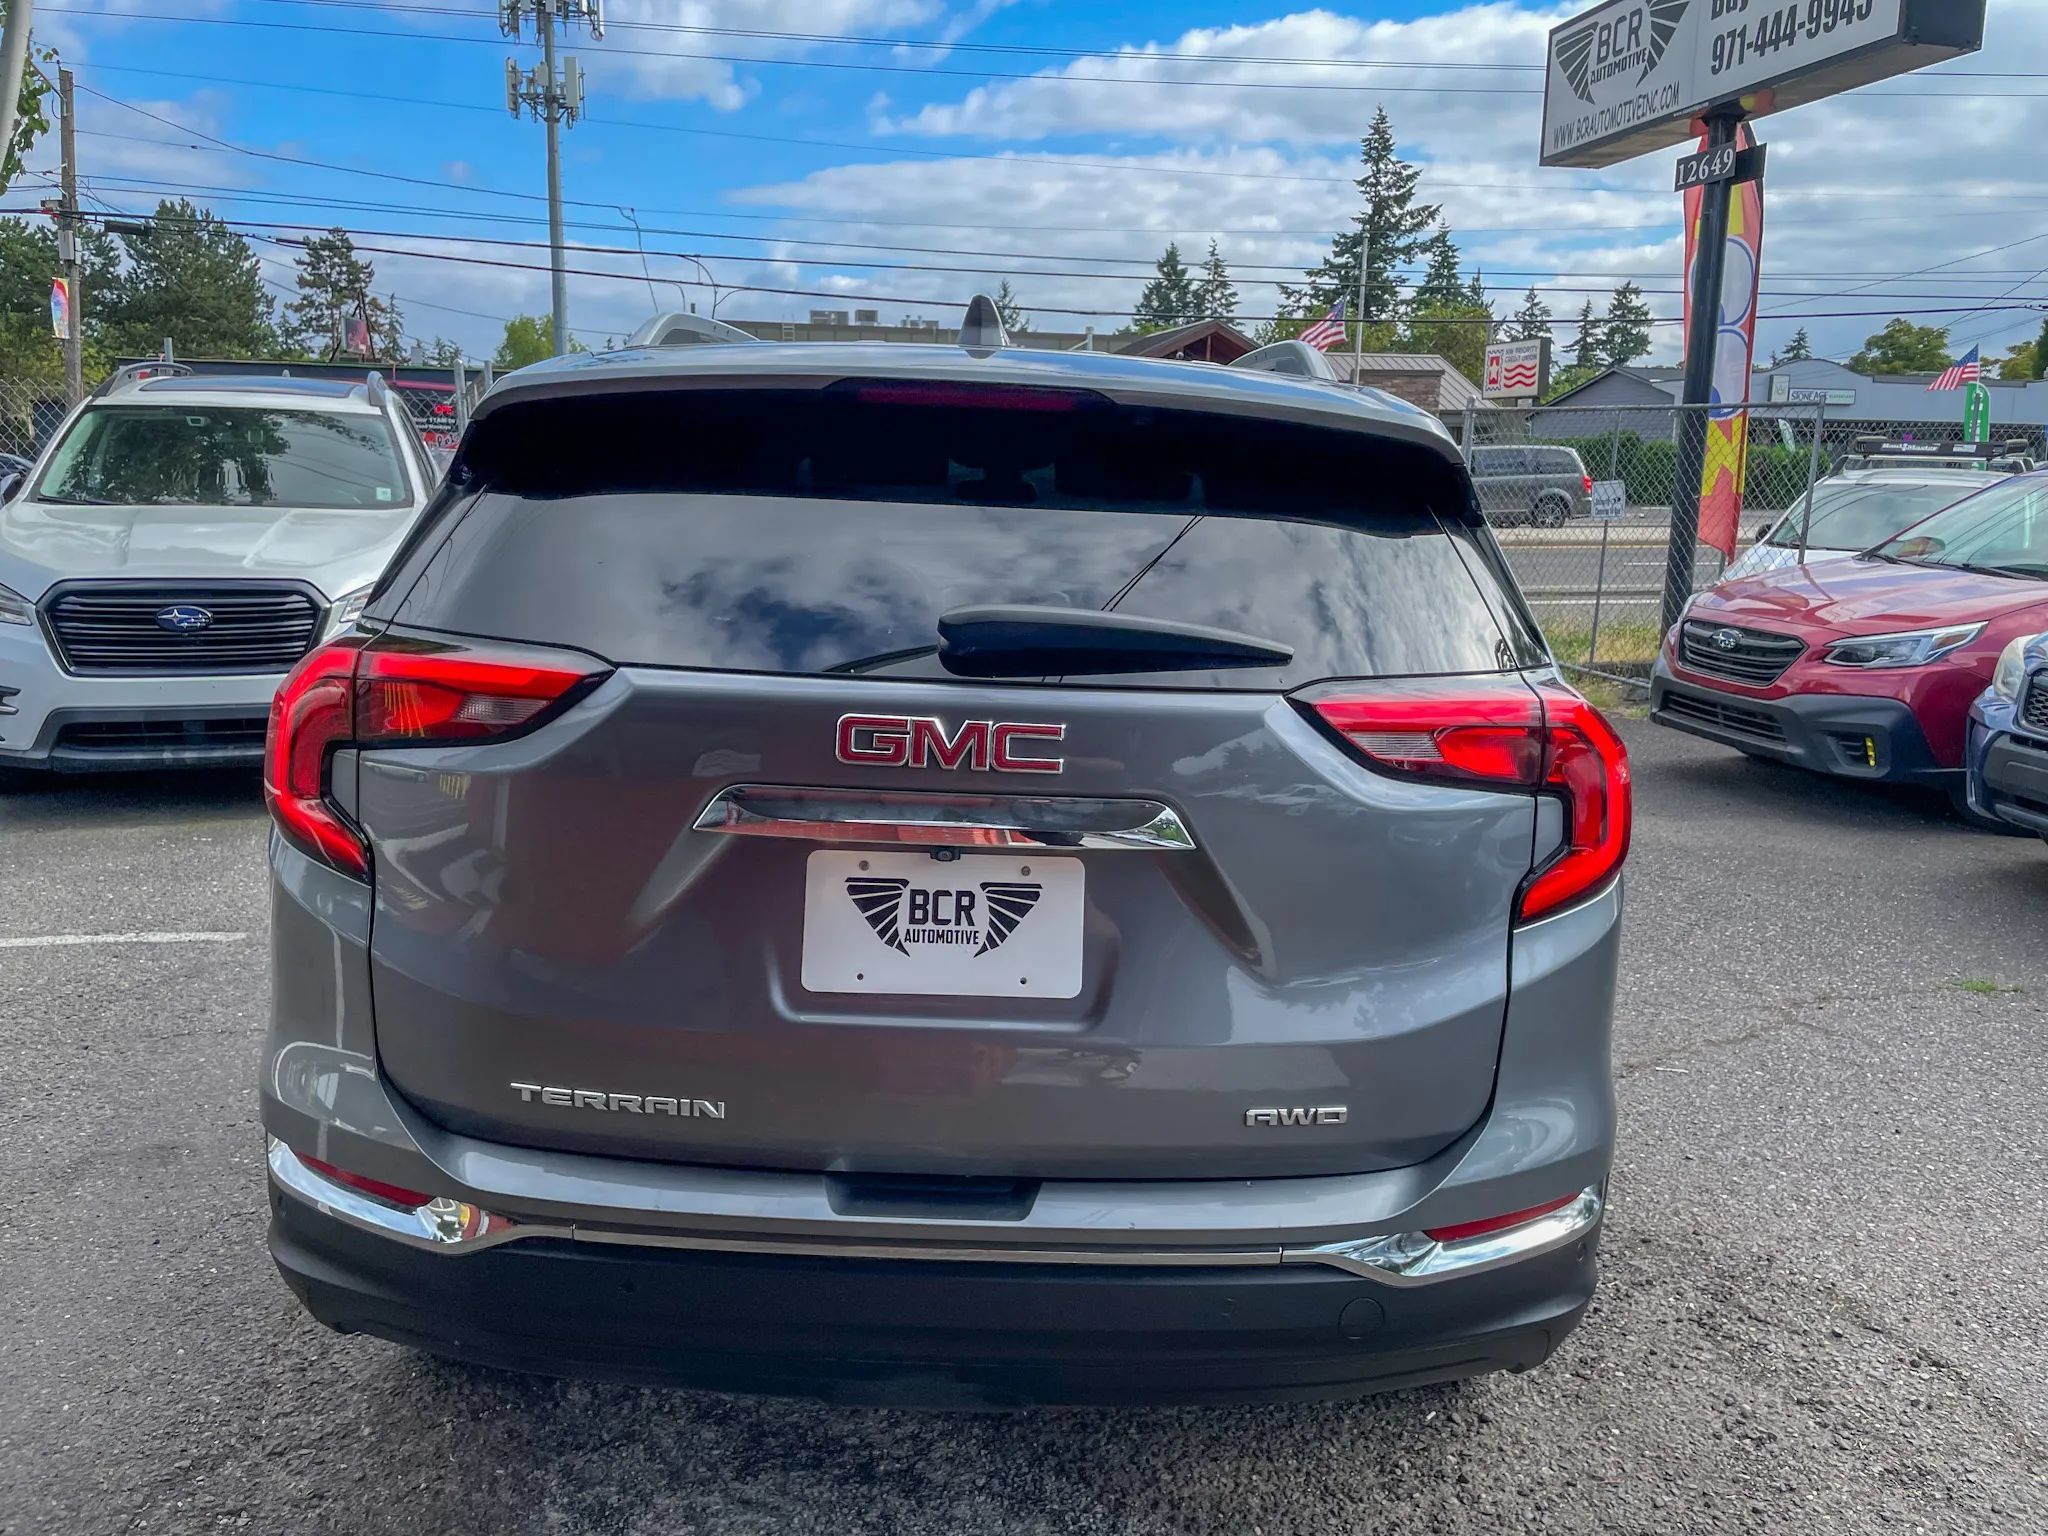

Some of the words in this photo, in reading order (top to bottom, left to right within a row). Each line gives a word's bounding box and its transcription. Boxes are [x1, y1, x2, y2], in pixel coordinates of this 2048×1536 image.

[1596, 8, 1643, 65] BCR
[1590, 48, 1648, 85] AUTOMOTIVE
[1553, 80, 1680, 149] WWW.BCRAUTOMOTIVEINC.COM
[1677, 148, 1734, 186] 12649
[836, 713, 1066, 774] GMC
[908, 888, 976, 926] BCR
[904, 928, 979, 945] AUTOMOTIVE
[510, 1082, 725, 1119] TERRAIN
[1246, 1107, 1347, 1126] AWD
